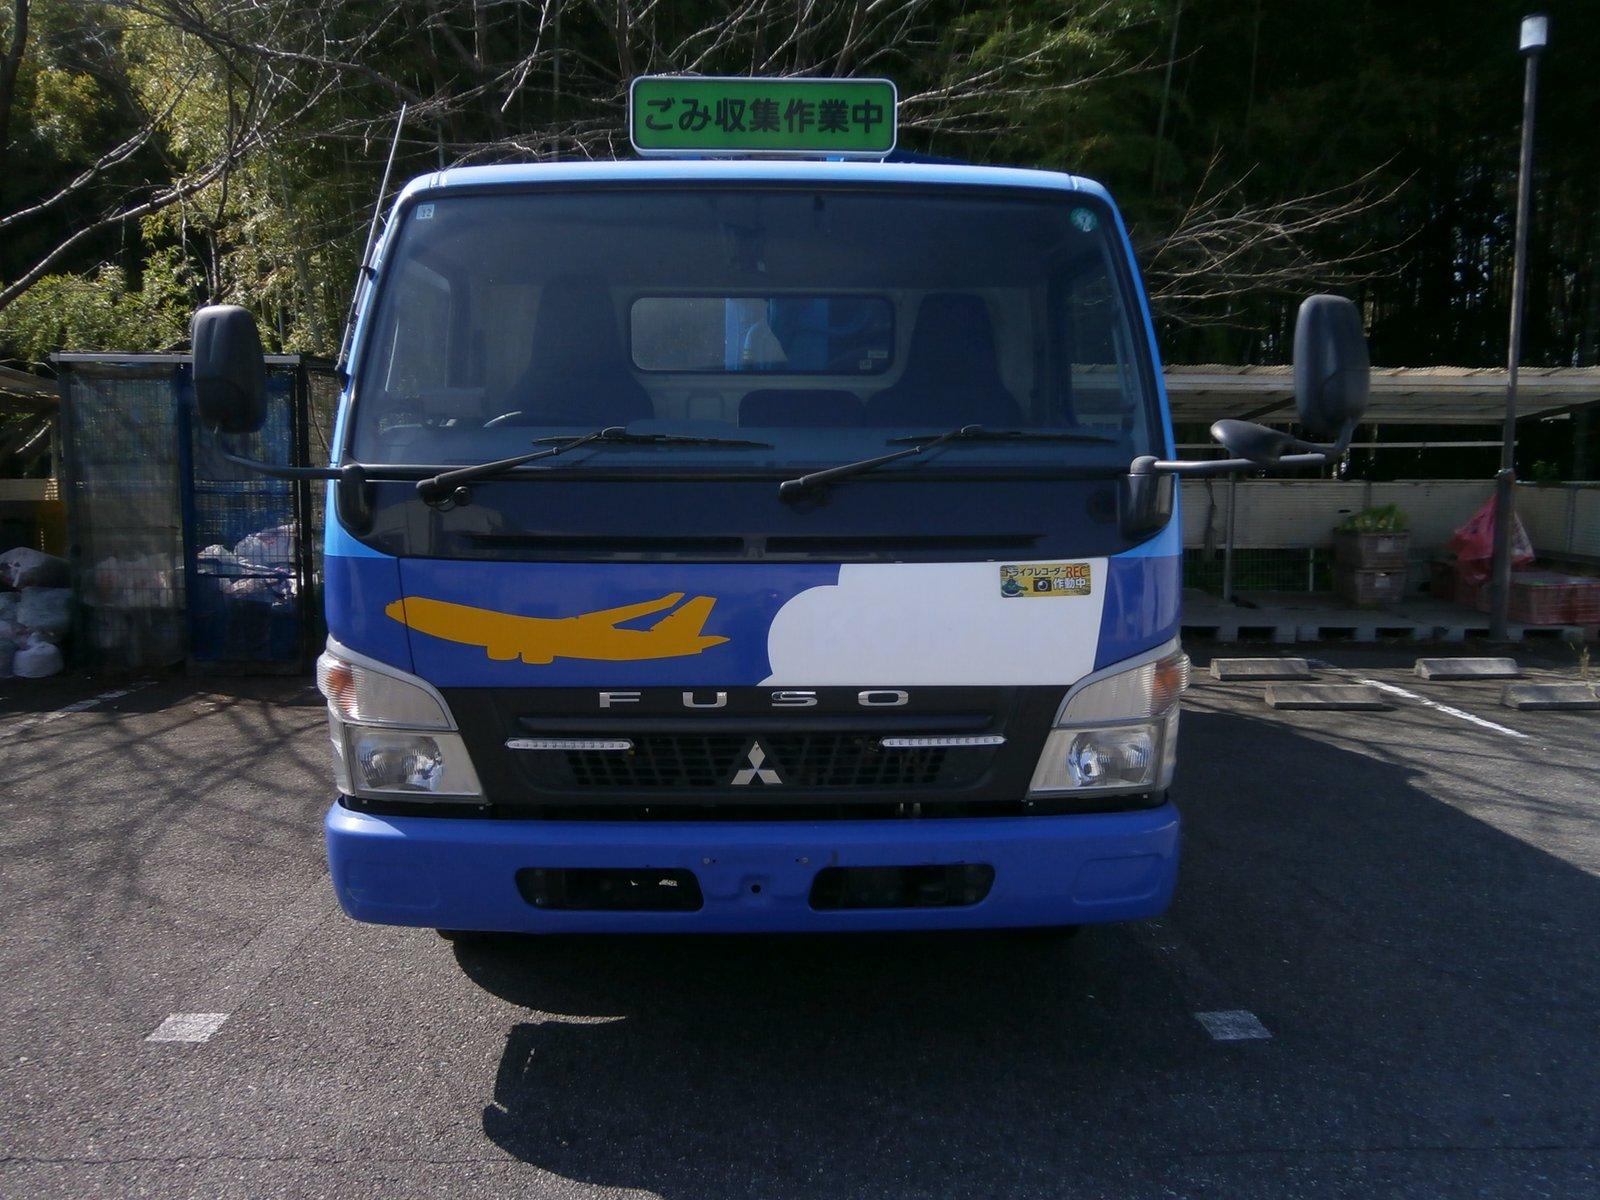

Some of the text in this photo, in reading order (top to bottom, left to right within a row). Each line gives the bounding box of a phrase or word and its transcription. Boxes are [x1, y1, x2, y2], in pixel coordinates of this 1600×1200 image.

[645, 98, 883, 133] ごみ収集作業中
[1065, 565, 1087, 578] REC
[599, 691, 909, 708] FUSO
